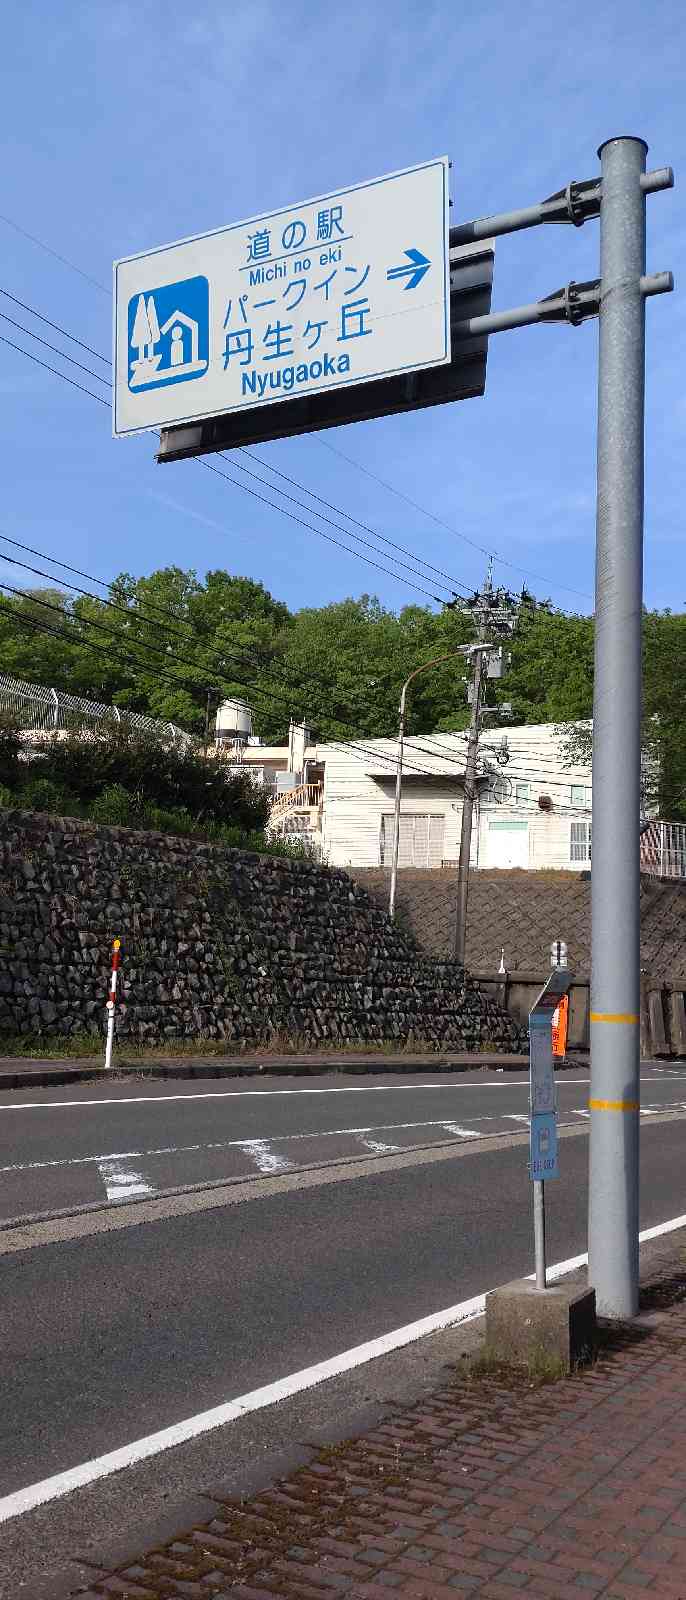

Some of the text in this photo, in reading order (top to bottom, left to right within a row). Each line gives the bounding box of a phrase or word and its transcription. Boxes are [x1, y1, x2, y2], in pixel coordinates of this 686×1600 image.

[246, 206, 343, 262] 道の駅
[249, 246, 342, 286] Michi no eki
[223, 265, 370, 329] パークイン
[241, 353, 350, 397] Nyugaoka
